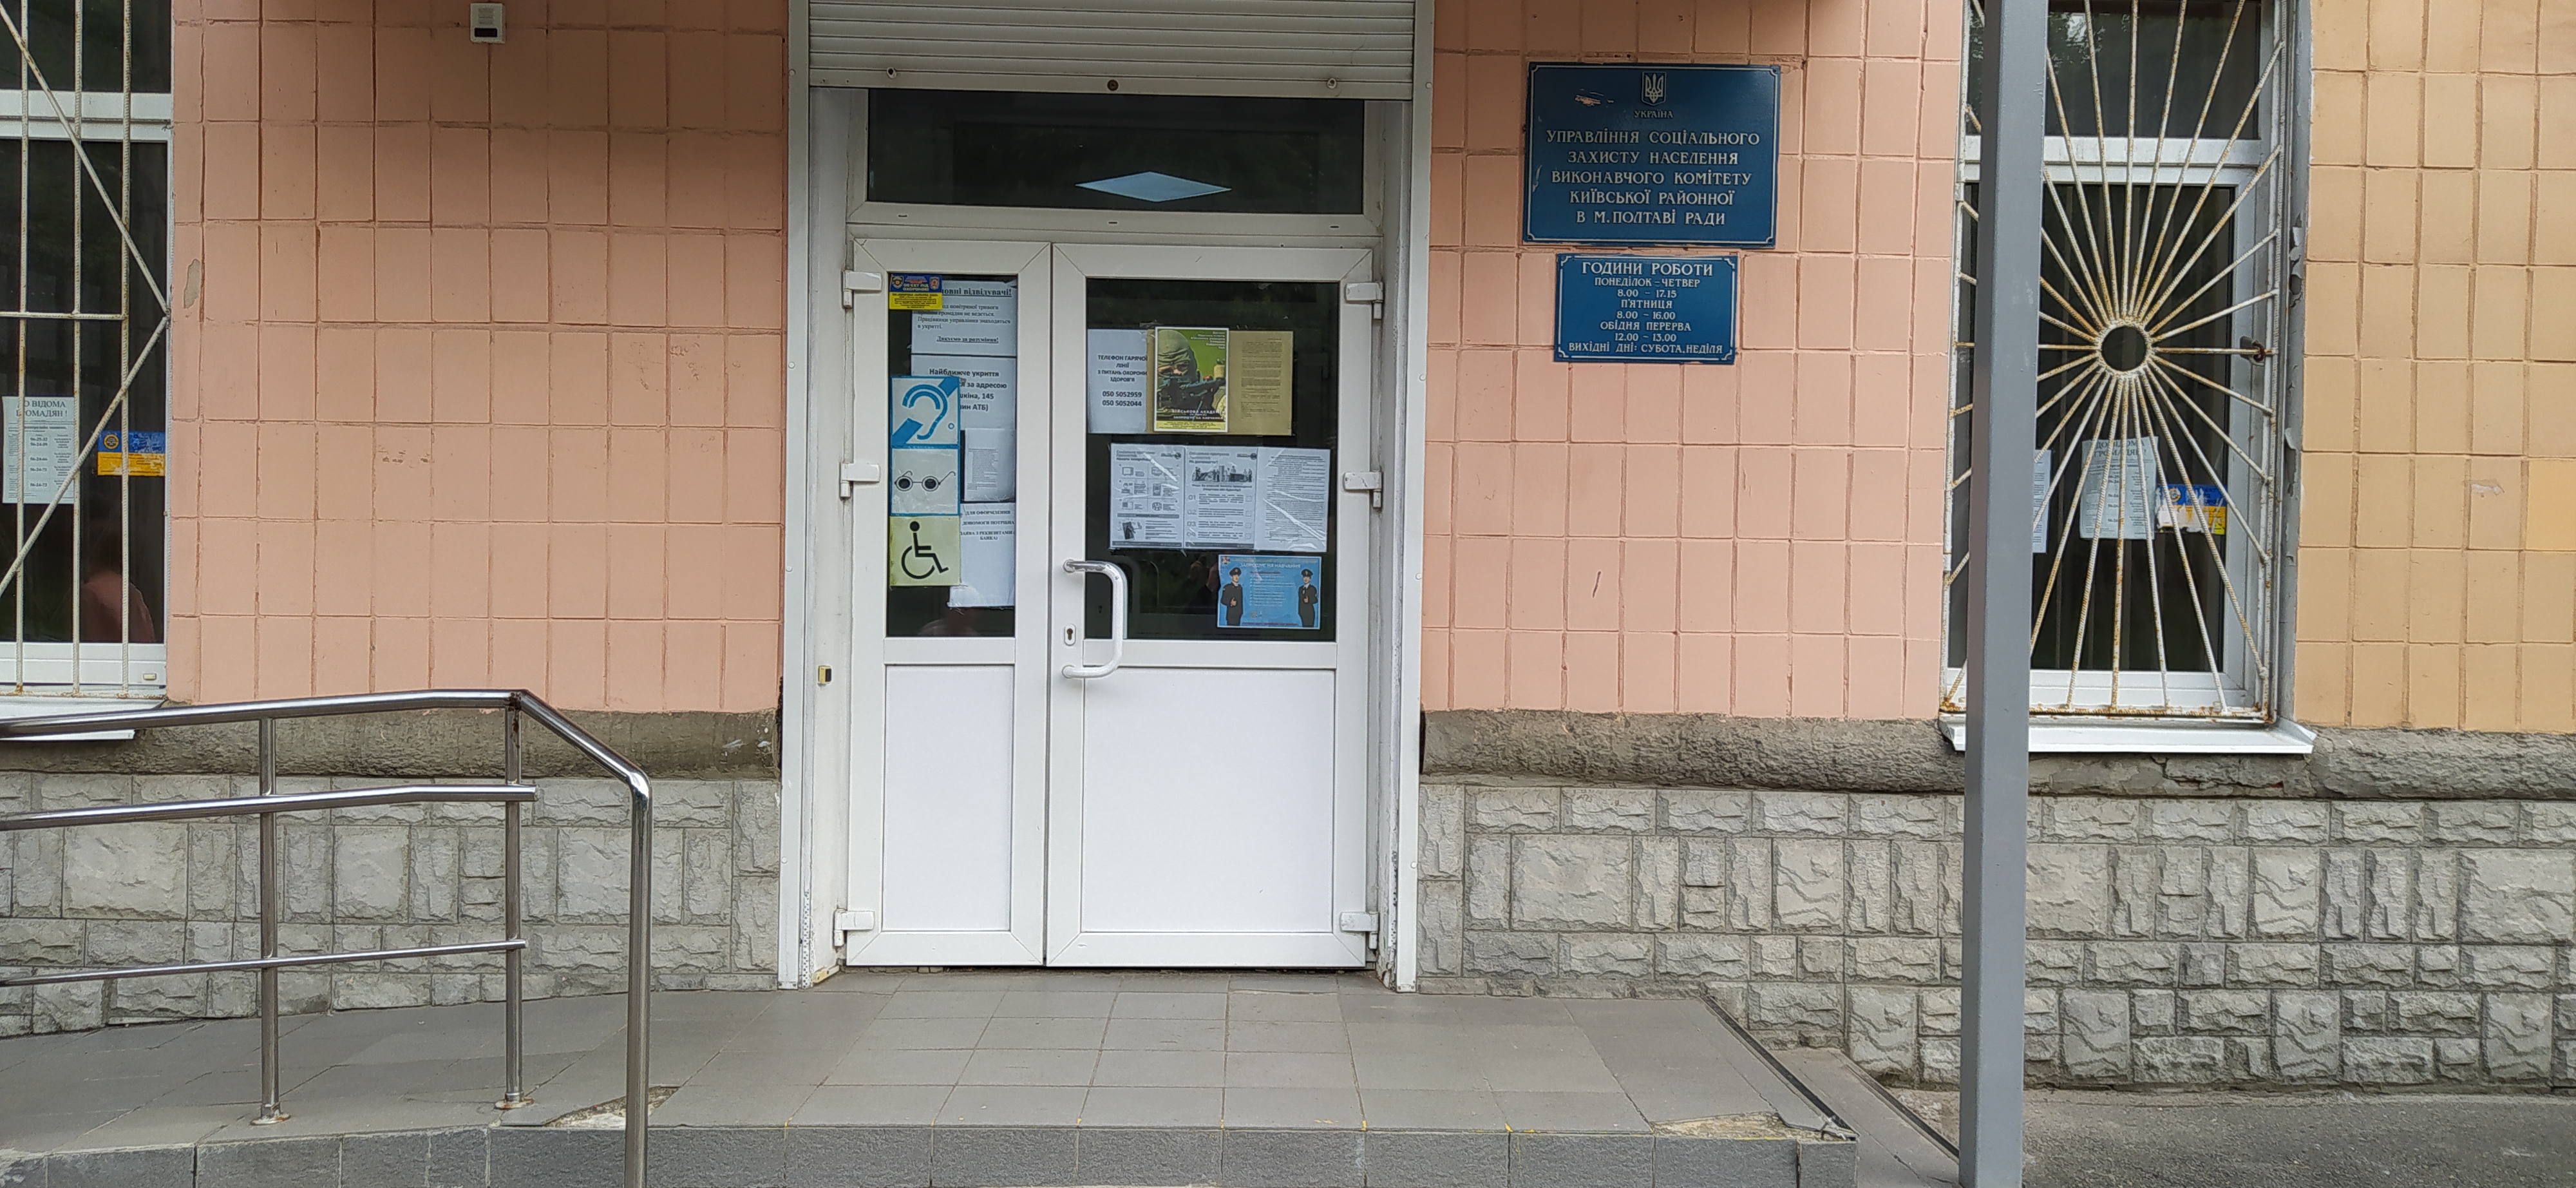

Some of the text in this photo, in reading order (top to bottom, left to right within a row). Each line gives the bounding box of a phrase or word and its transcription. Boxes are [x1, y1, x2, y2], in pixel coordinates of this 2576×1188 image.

[1634, 110, 1673, 119] УКРАЇНА
[1546, 128, 1759, 146] УПРАВЛІННЯ СОЦІАЛЬНОГО
[1568, 151, 1738, 165] ЗАХИСТУ НАСЕЛЕННЯ
[1551, 170, 1752, 186] ВИКОНАВЧОГО КОМІТЕТУ
[1569, 189, 1735, 206] КИЇВСЬКОЇ РАЙОННОЇ
[1576, 211, 1586, 223] В
[1685, 212, 1725, 226] РАДИ
[1582, 262, 1713, 276] ГОДИНИ РОБОТИ
[1617, 289, 1639, 298] 8.00
[1656, 290, 1677, 298] 17.15
[1621, 299, 1672, 309] П'ЯТНИЦЯ
[1616, 311, 1638, 320] 8.00
[1653, 312, 1676, 320] 16.00
[1600, 321, 1692, 332] ОБІДНЯ ПЕРЕРВА
[1615, 333, 1639, 341] 12.00
[1653, 334, 1677, 342] 13.00
[1569, 341, 1610, 352] ВИХІДНІ
[1616, 341, 1638, 354] ДНІ:
[929, 368, 971, 377] Найближче
